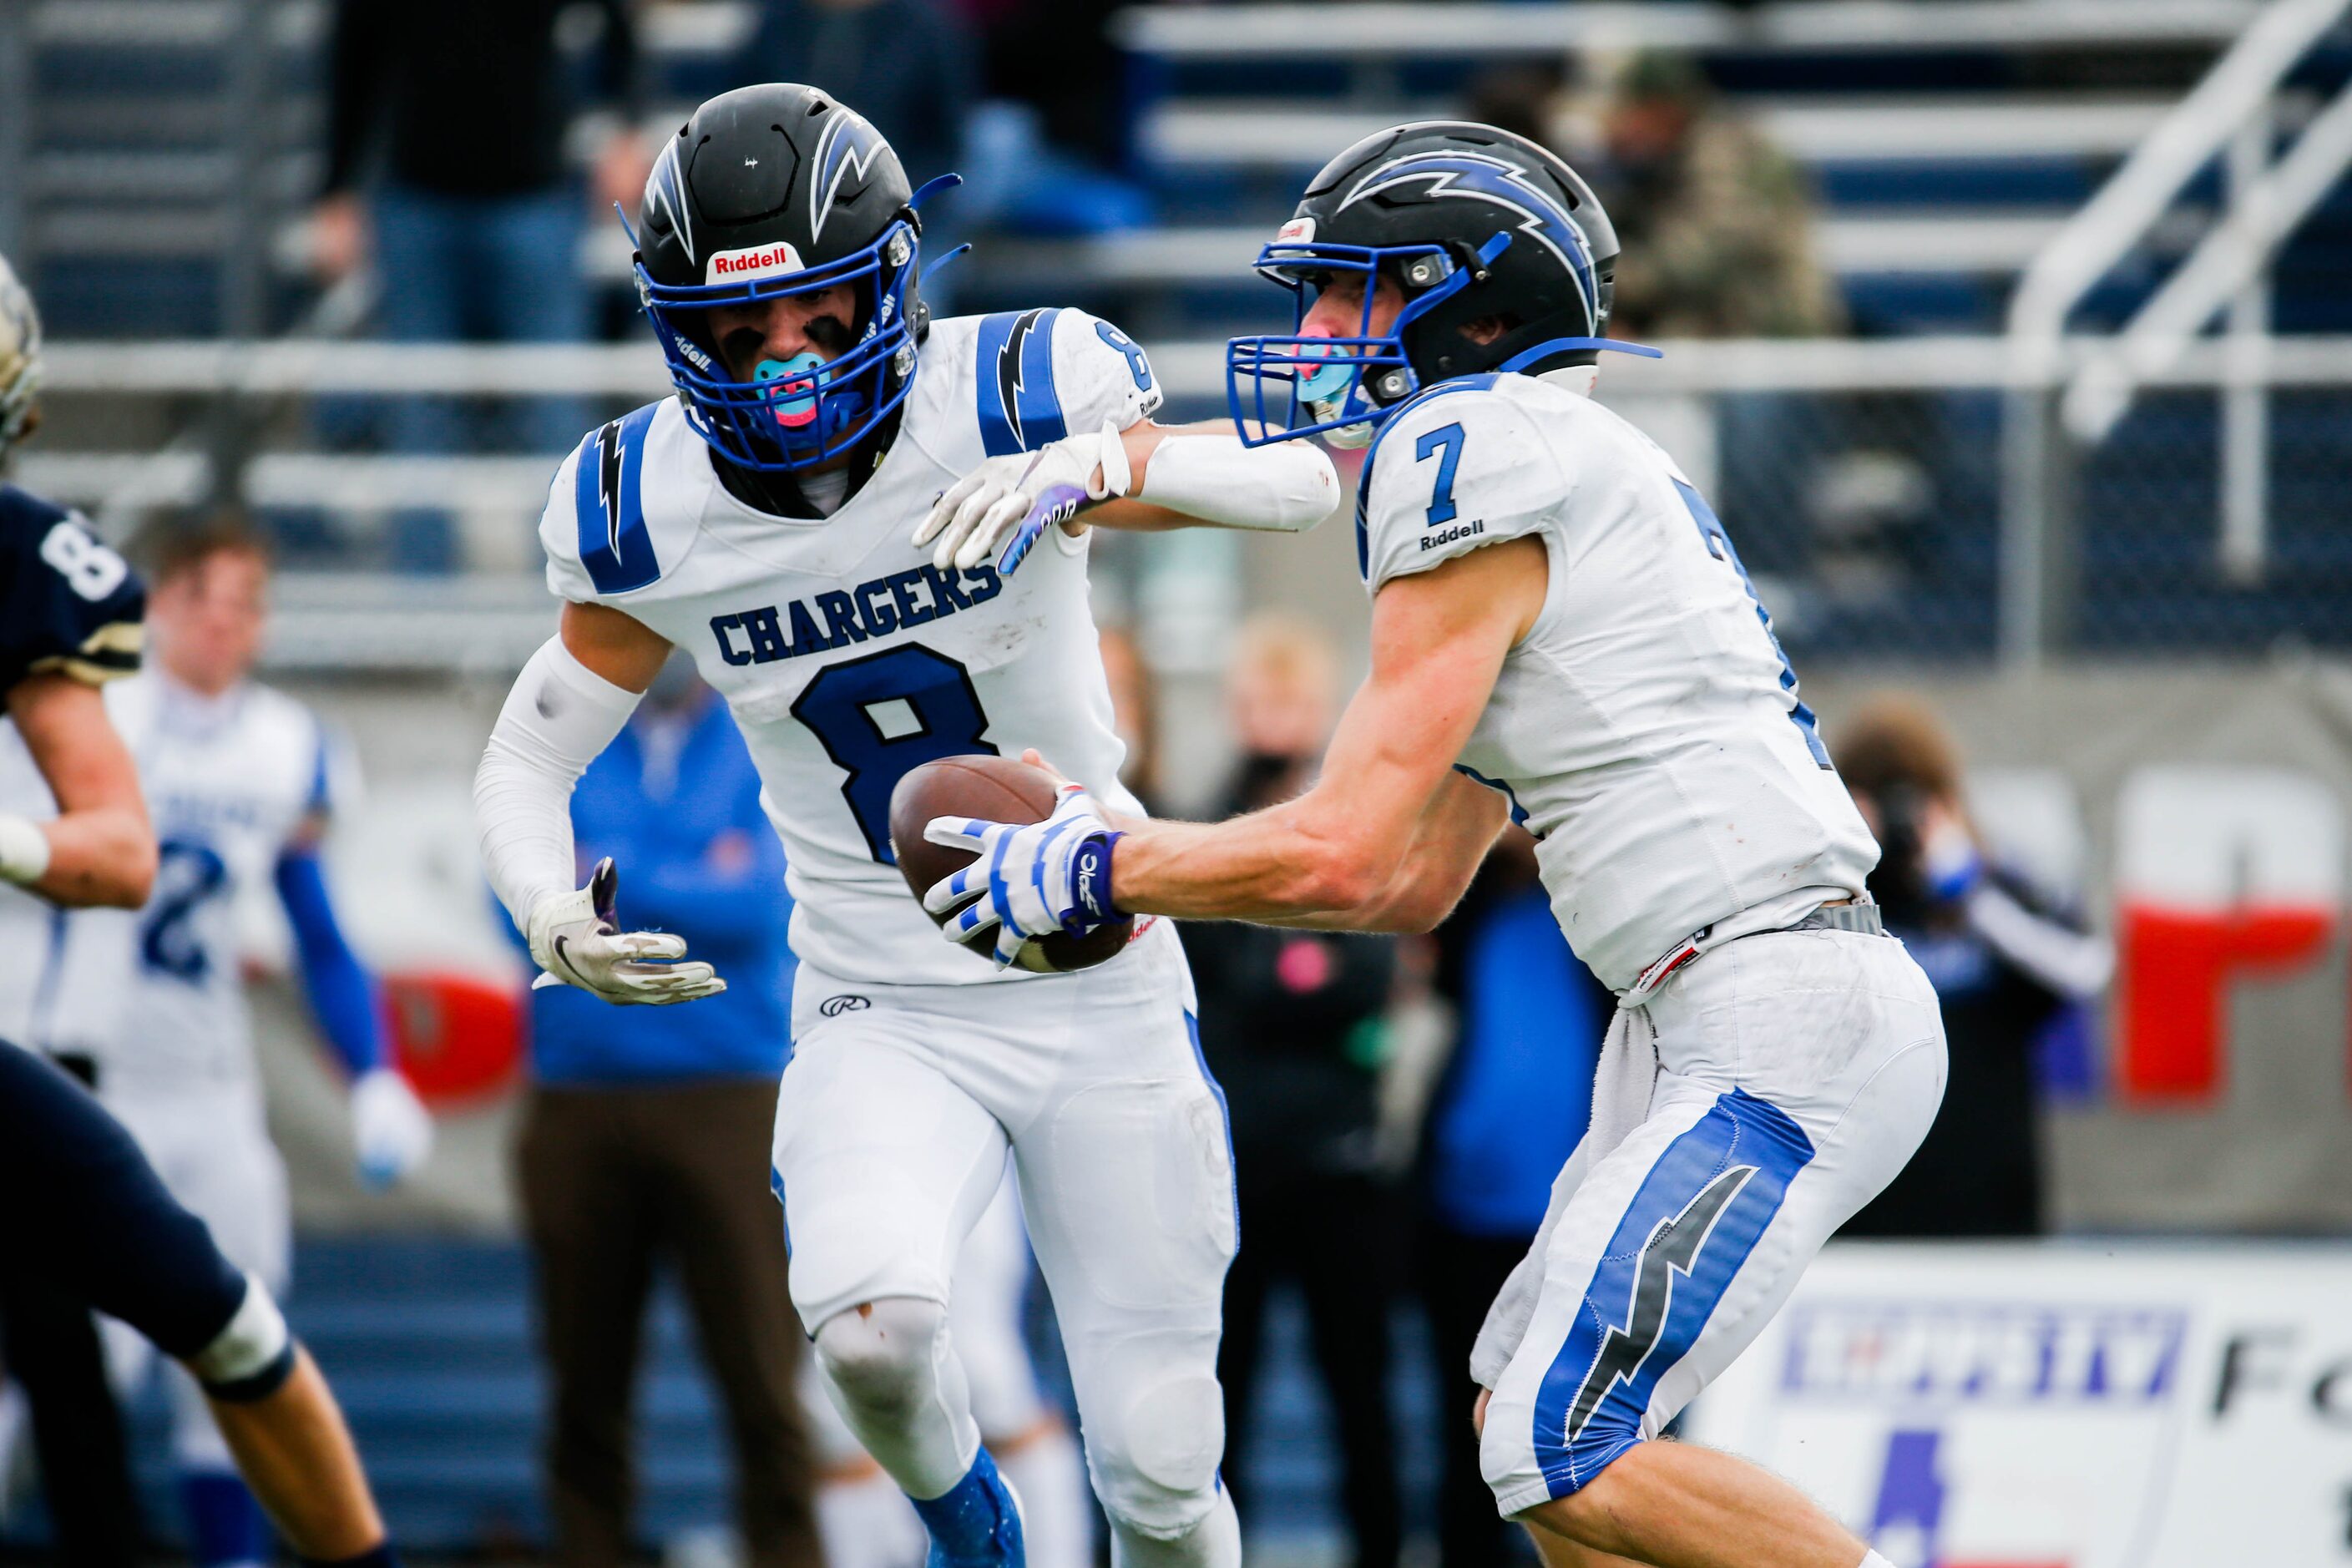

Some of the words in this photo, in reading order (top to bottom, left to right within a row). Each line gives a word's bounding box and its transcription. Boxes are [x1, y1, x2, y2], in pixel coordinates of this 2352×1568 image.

[715, 247, 787, 274] Riddell
[1094, 321, 1152, 392] 8
[1416, 421, 1466, 528] 7
[1420, 518, 1484, 551] Riddell
[710, 552, 1003, 666] CHARGERS
[789, 640, 1001, 867] 8
